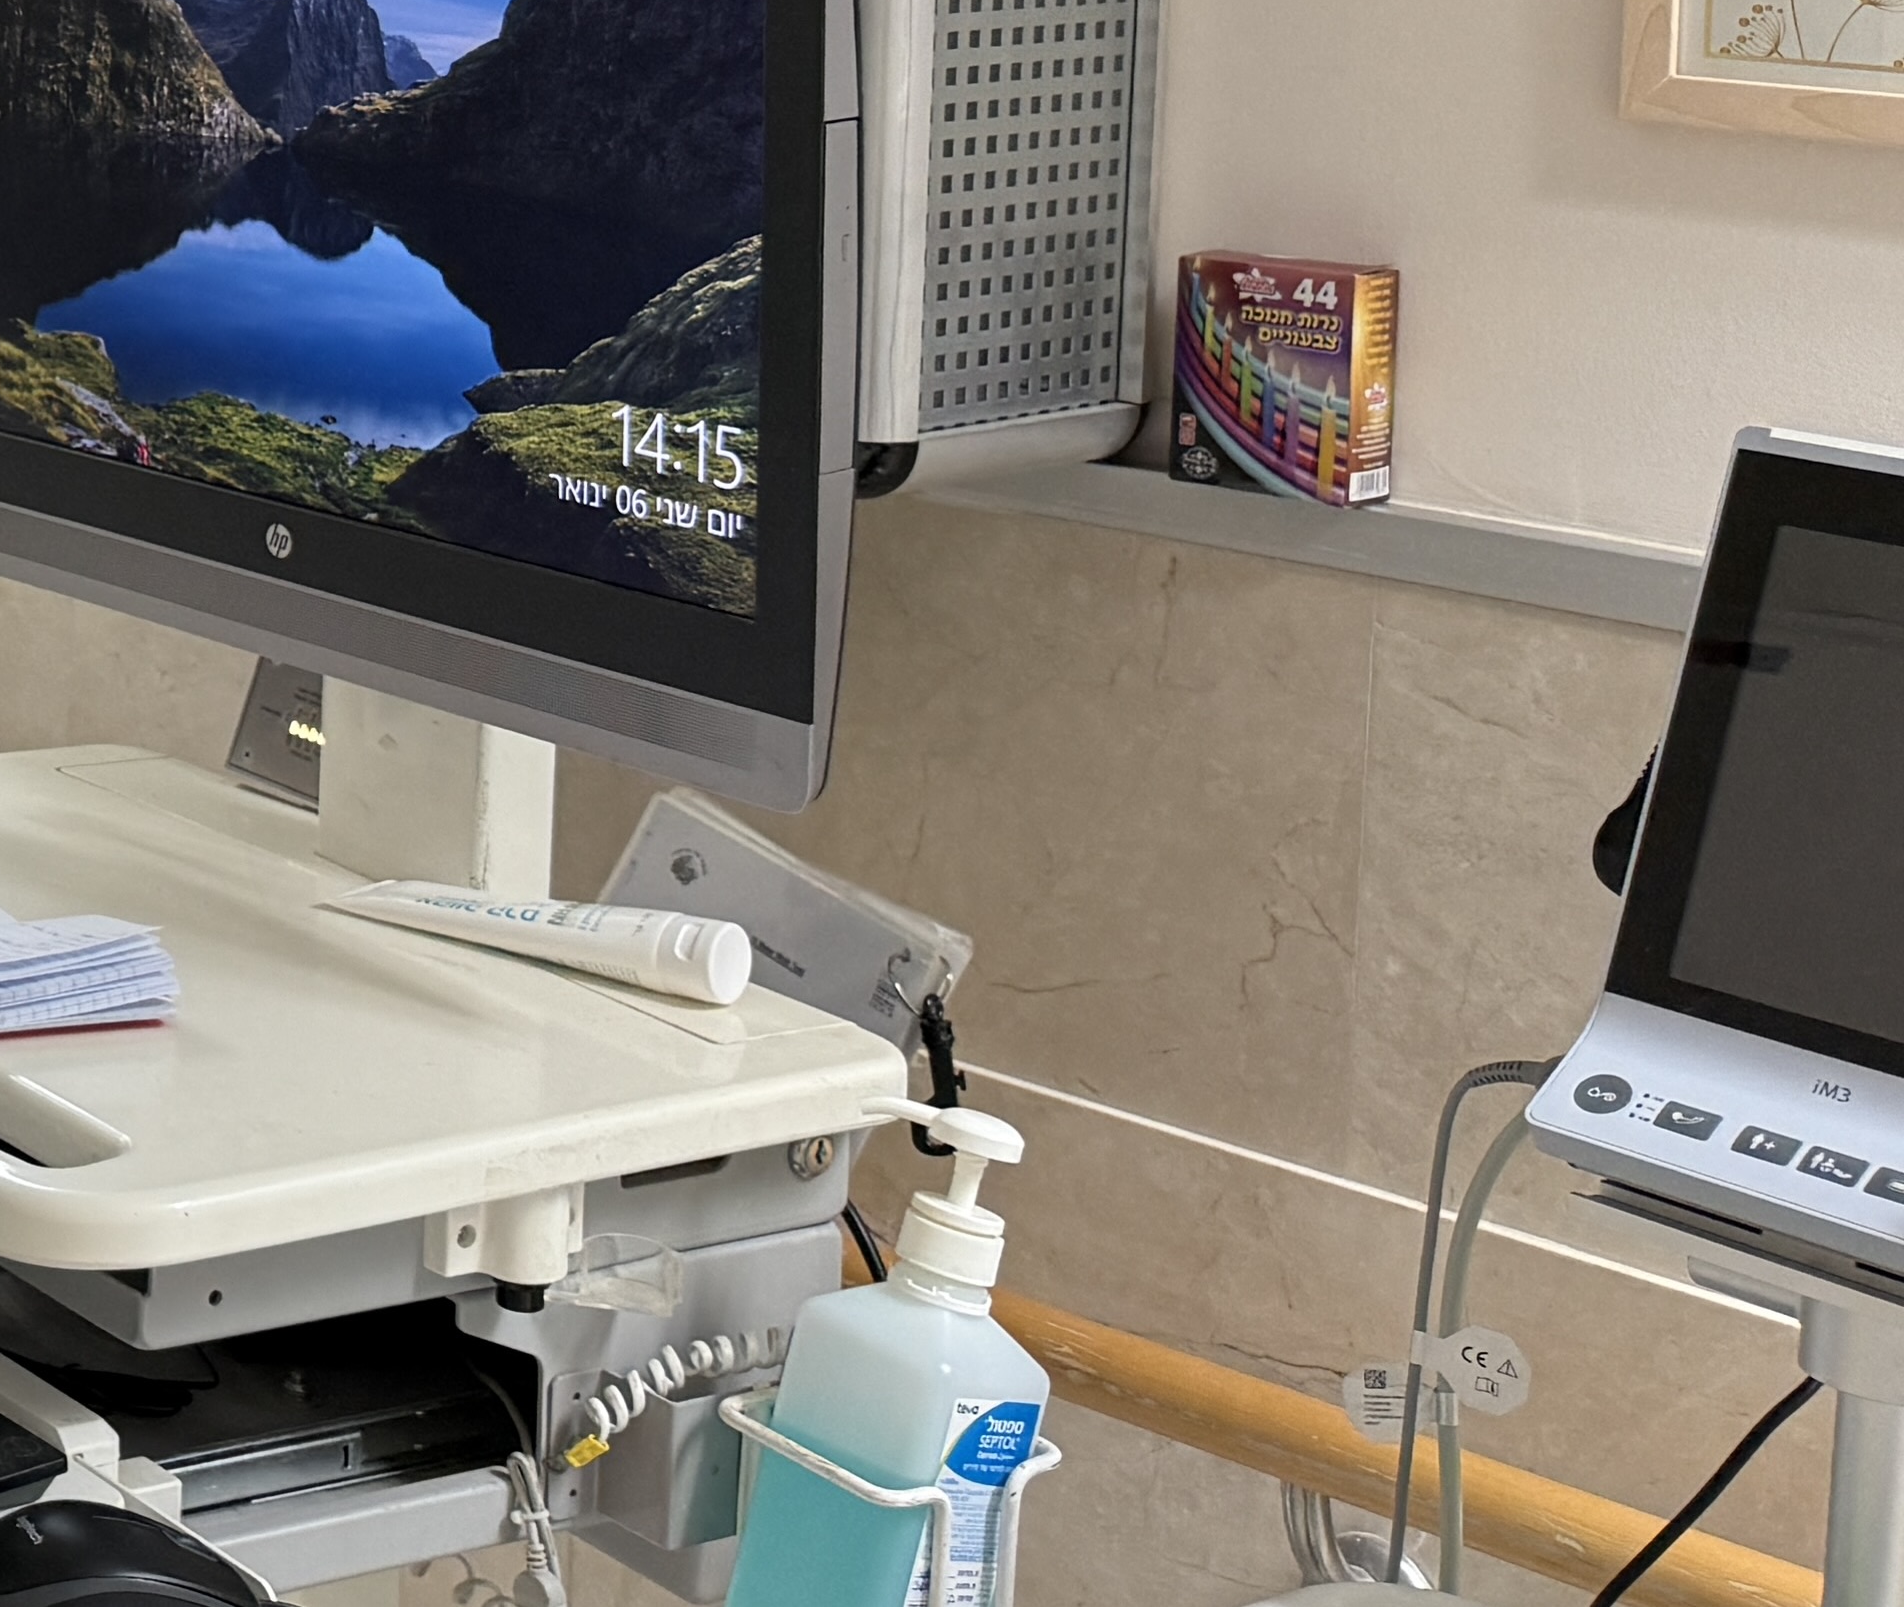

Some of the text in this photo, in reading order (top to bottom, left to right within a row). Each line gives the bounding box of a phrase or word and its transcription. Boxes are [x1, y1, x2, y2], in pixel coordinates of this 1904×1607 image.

[1292, 278, 1339, 311] 44
[1241, 305, 1342, 332] נרות חנוכה
[1257, 326, 1340, 351] צבעוניים
[612, 404, 745, 490] 14:15
[548, 473, 743, 539] יום שני 06 ינואר
[268, 523, 290, 558] hp
[1811, 1078, 1852, 1103] iM3
[1461, 1346, 1489, 1368] CE
